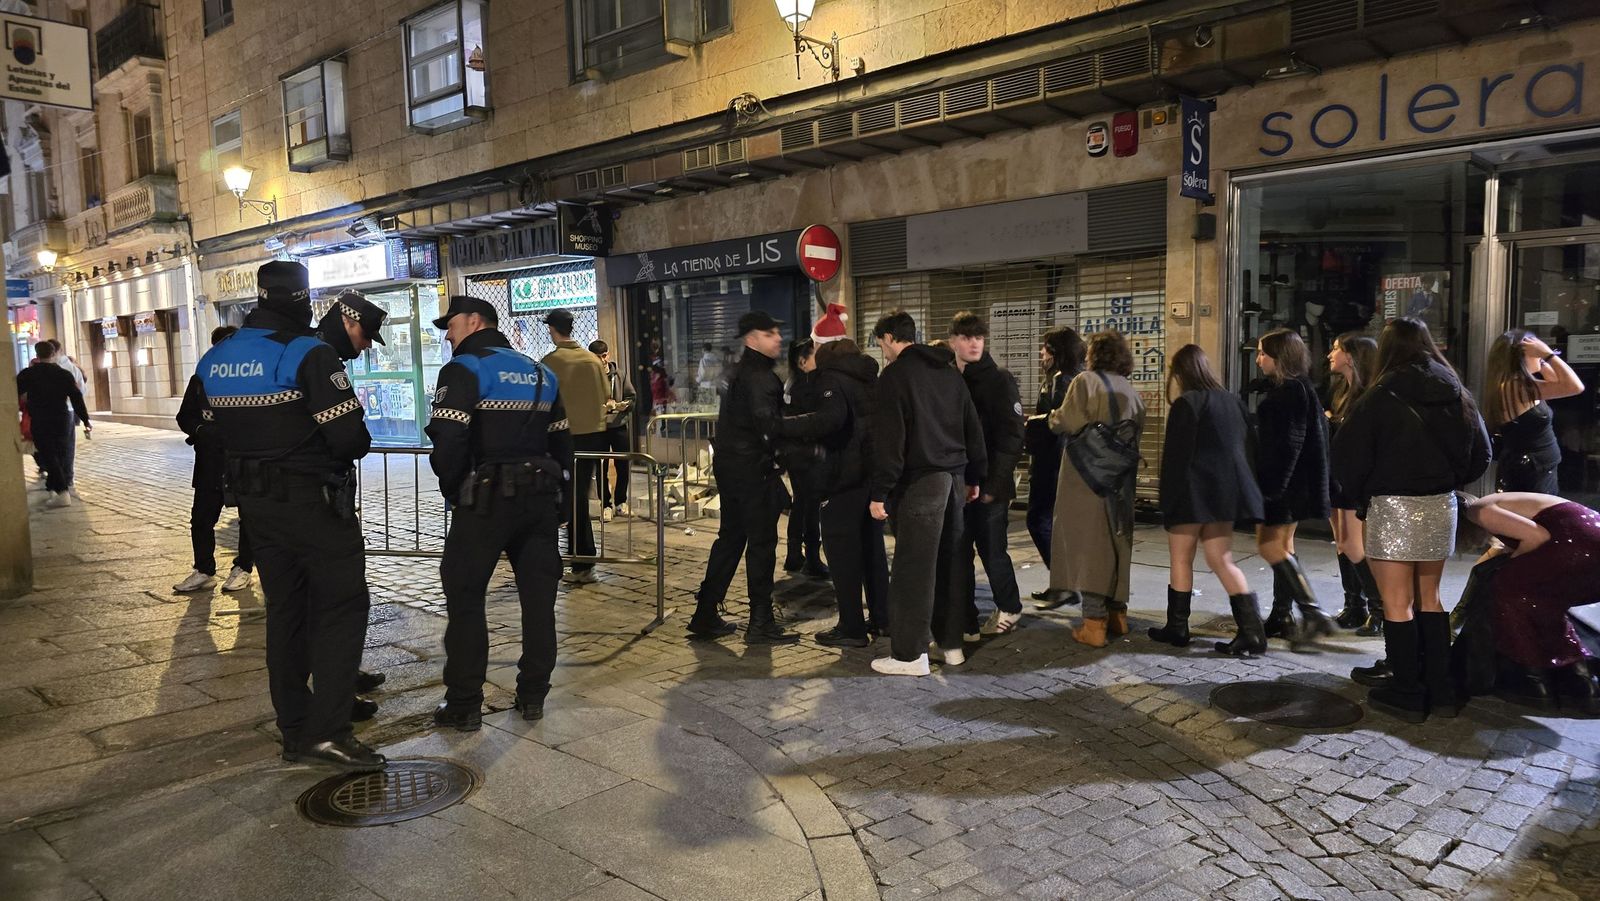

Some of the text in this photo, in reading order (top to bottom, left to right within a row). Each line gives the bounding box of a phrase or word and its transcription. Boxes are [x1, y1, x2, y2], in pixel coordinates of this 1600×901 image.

[9, 75, 70, 90] Apuestas del
[9, 84, 42, 95] Estado
[1258, 61, 1585, 157] solera
[1114, 124, 1132, 132] FUEGO
[1183, 171, 1208, 190] solera
[569, 234, 603, 244] SHOPPING
[574, 242, 599, 251] MUSEO
[664, 238, 781, 277] LA TIENDA DE LIS
[1385, 276, 1422, 290] OFERTA
[1110, 297, 1133, 315] SE
[1384, 290, 1398, 320] TRAJES
[1082, 316, 1163, 335] ALQUILA
[209, 360, 264, 378] POLICÍA
